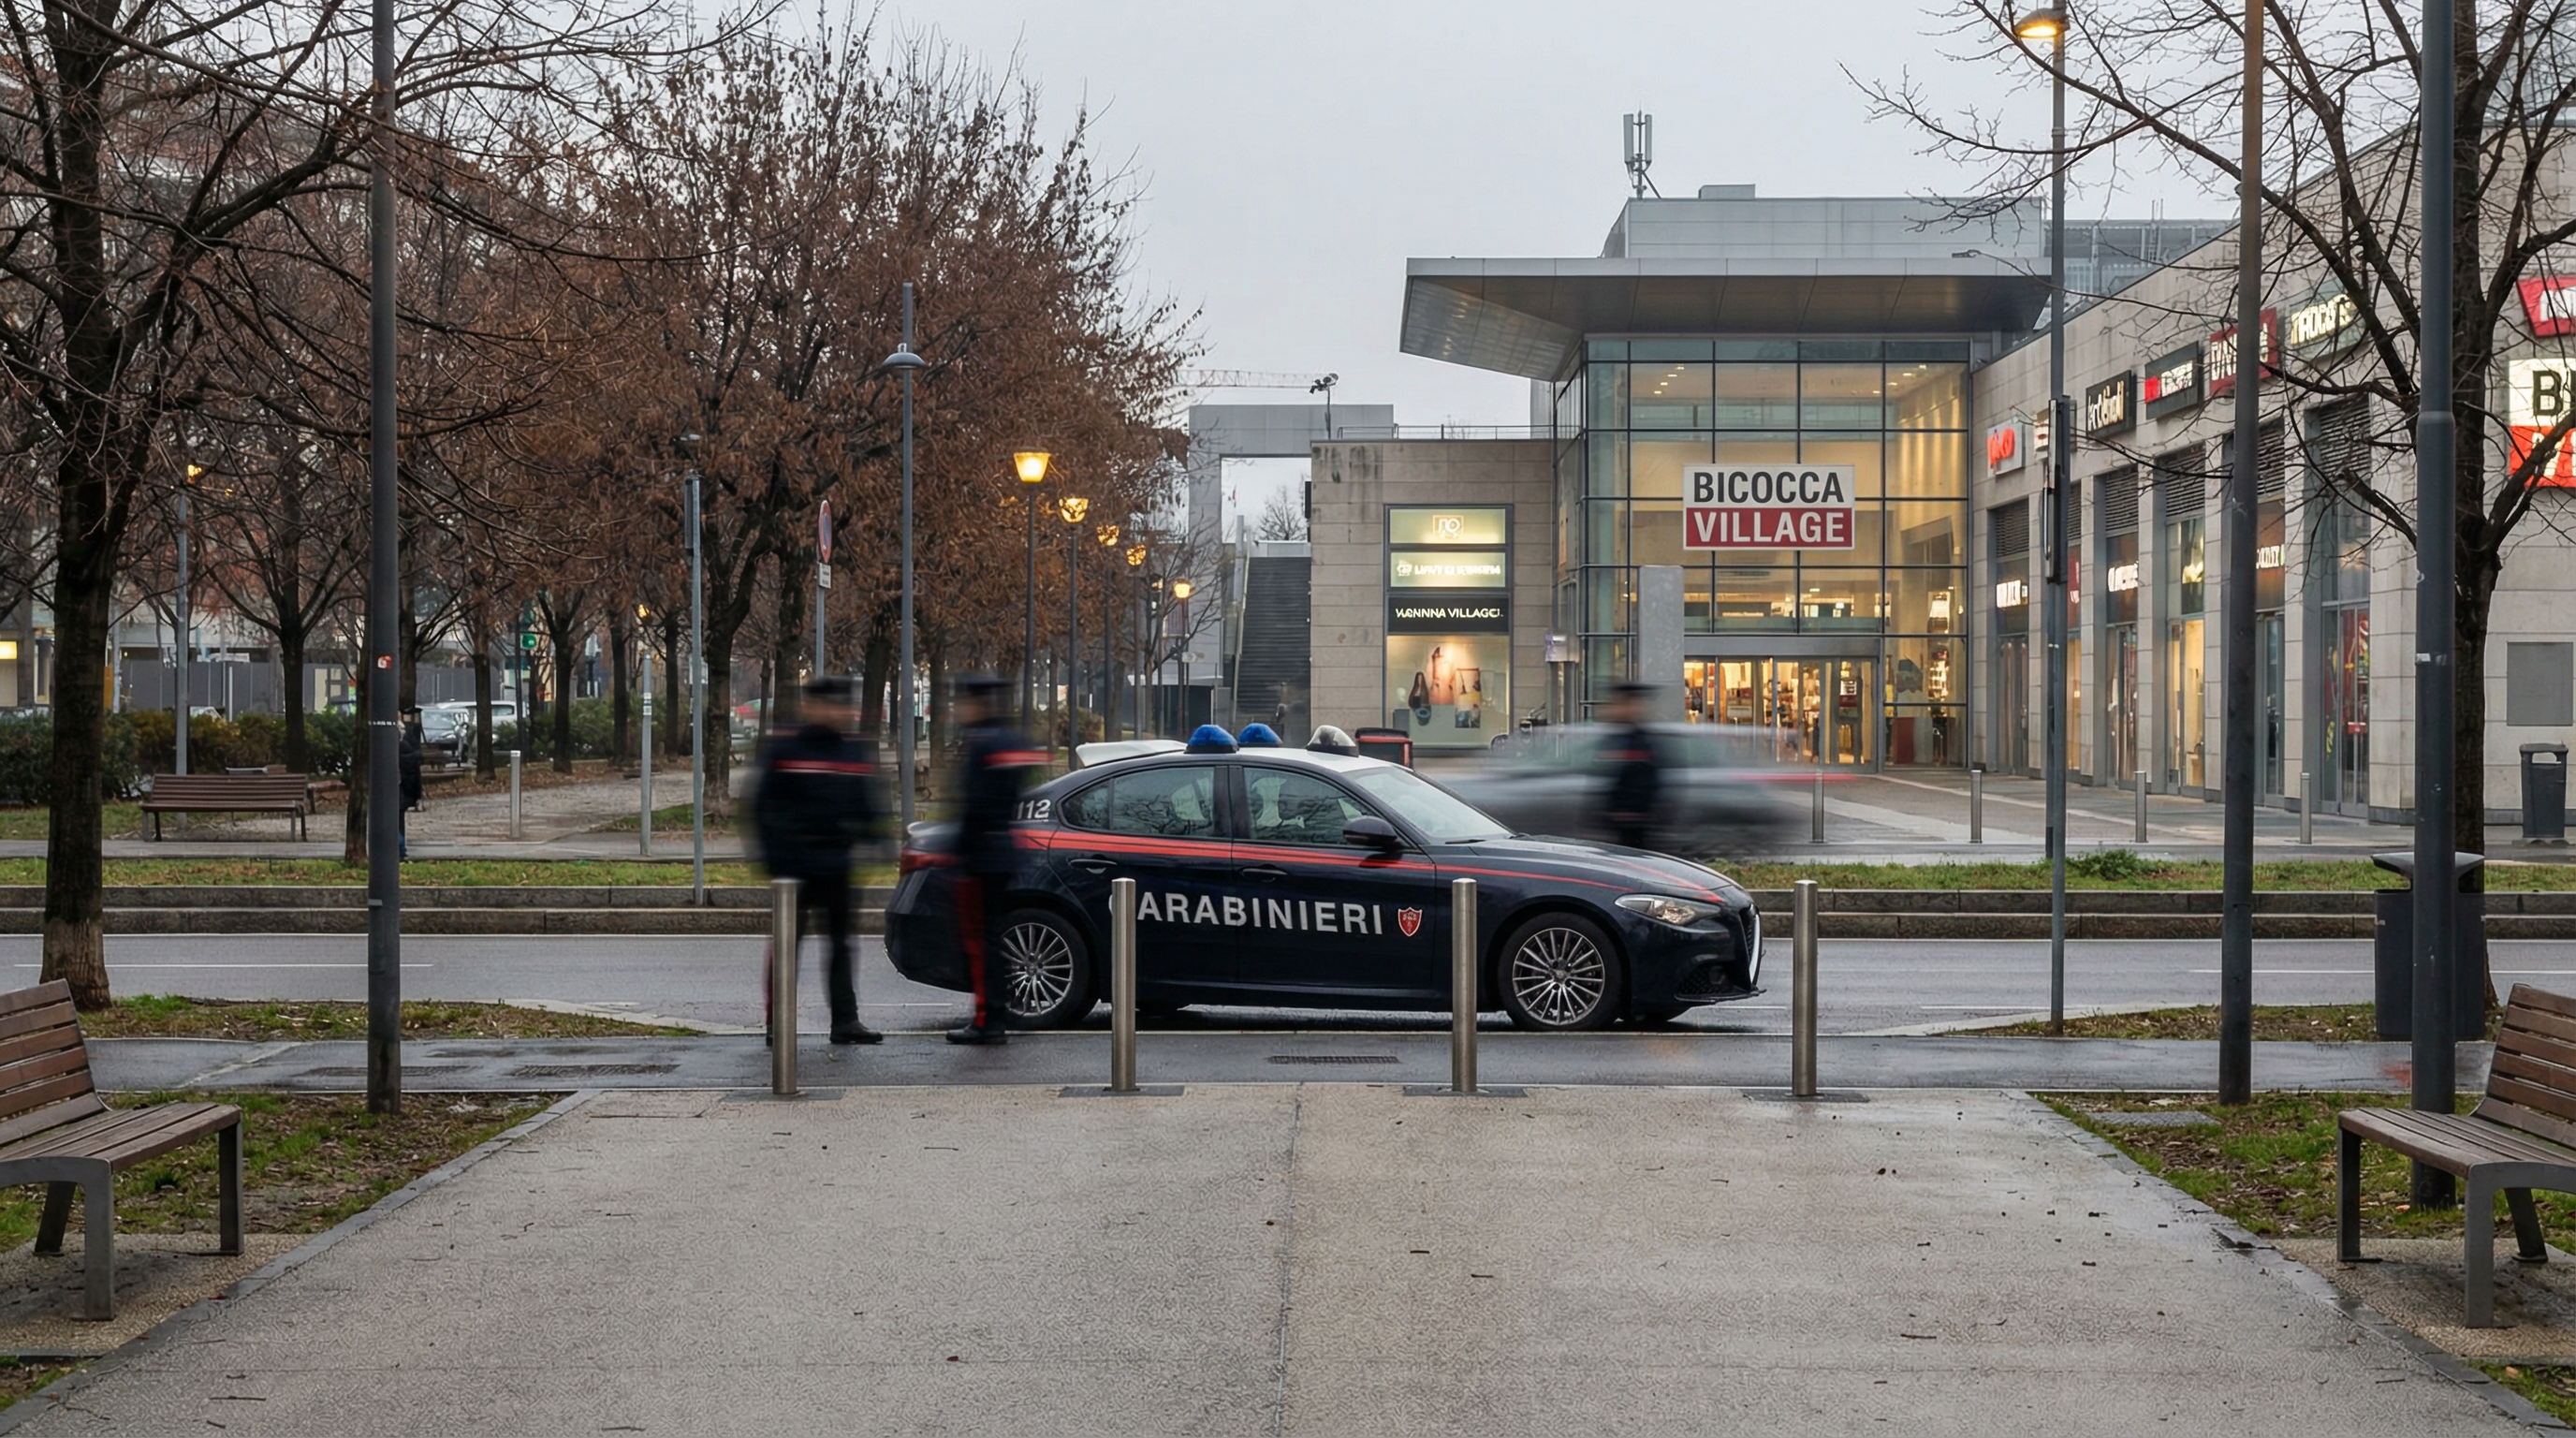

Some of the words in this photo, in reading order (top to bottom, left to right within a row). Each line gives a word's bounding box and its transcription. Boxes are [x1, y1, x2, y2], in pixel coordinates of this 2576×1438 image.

[1693, 471, 1844, 504] BICOCCA
[1693, 511, 1844, 543] VILLAGE
[1017, 799, 1051, 820] 112
[1108, 891, 1383, 935] ARABINIERI
